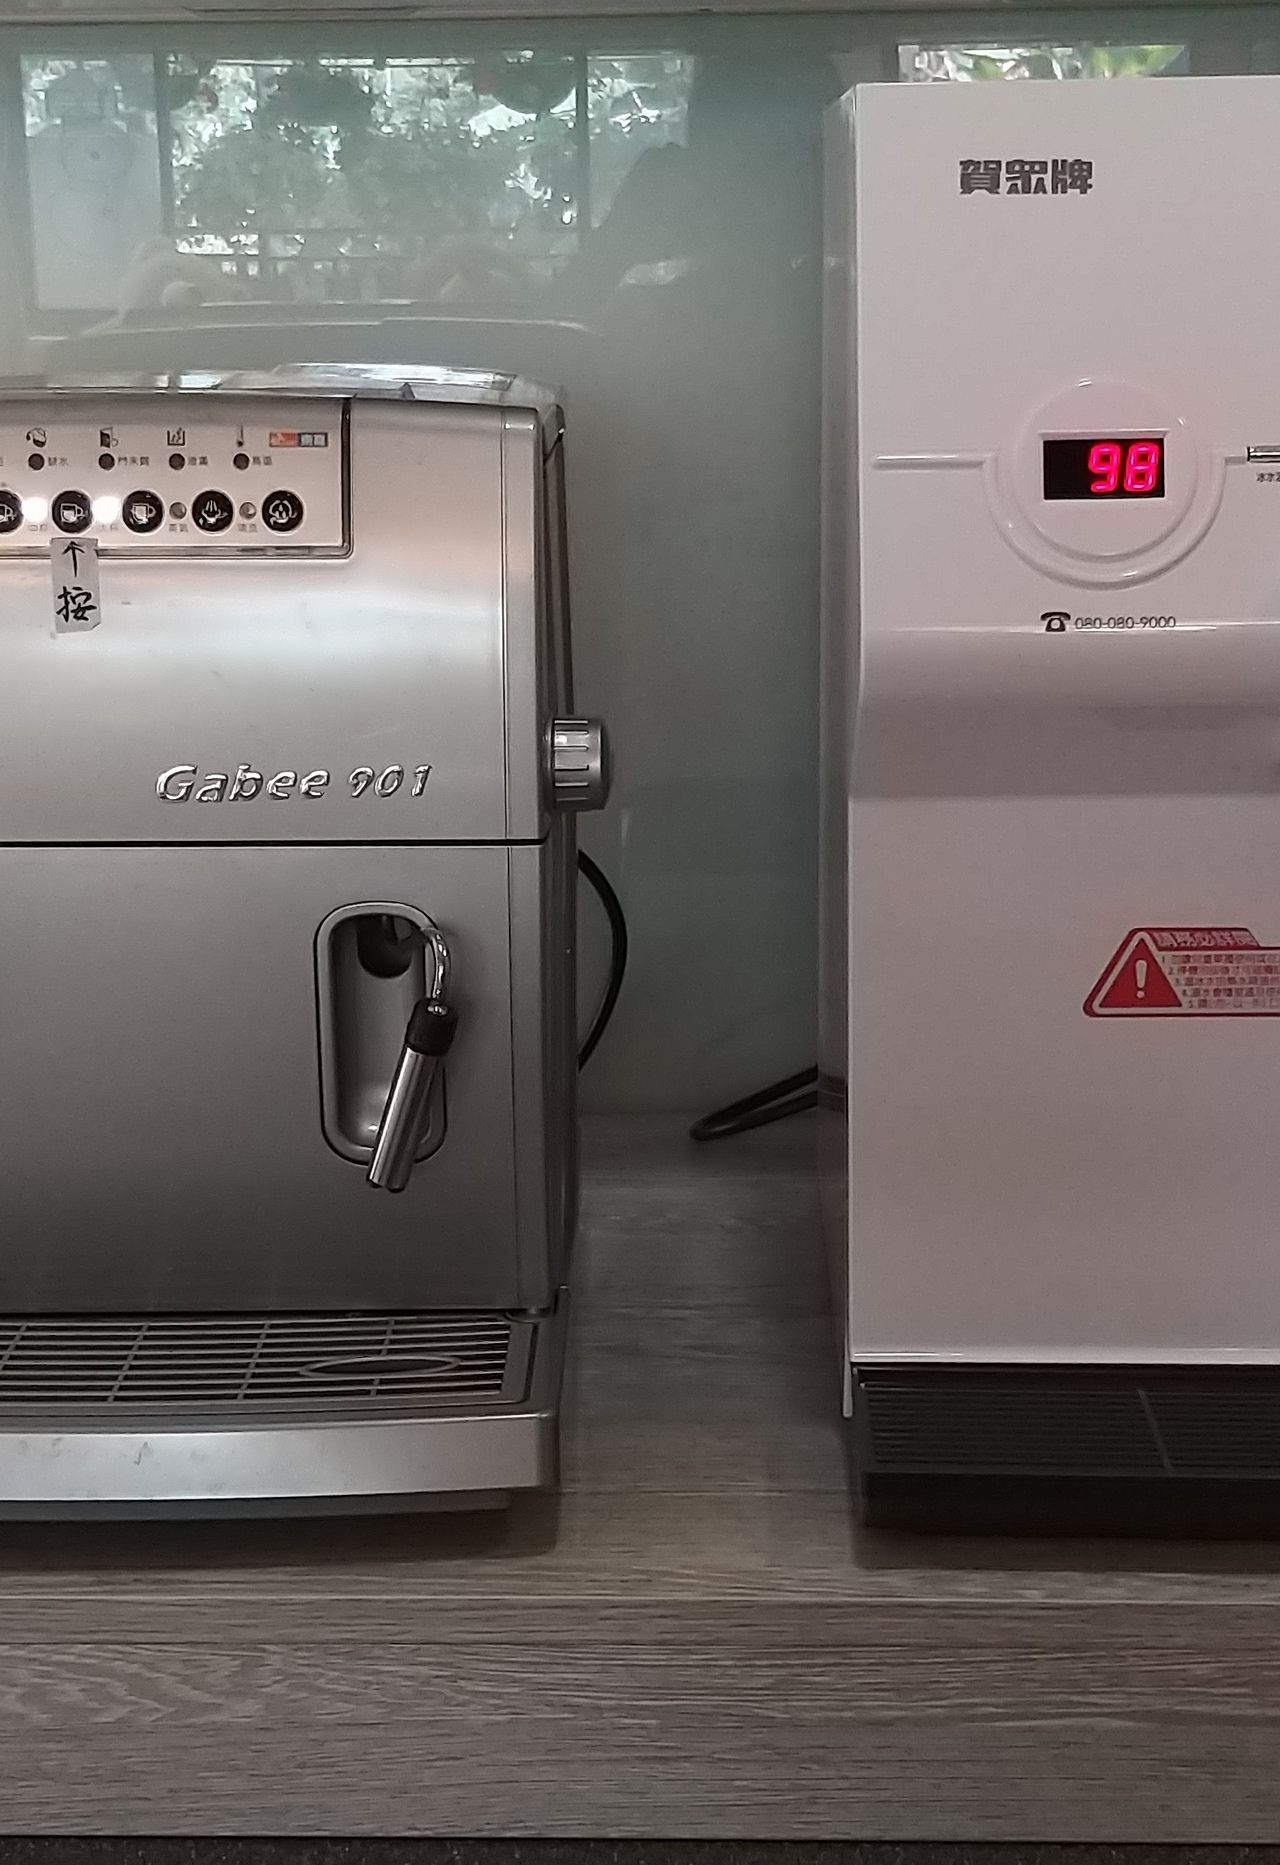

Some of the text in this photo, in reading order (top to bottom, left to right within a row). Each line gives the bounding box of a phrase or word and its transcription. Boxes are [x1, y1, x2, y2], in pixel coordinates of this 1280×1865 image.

[959, 159, 1093, 194] 賀眾牌
[1088, 443, 1160, 493] 98
[56, 586, 98, 623] 按
[1075, 616, 1176, 629] 080-080-9000
[154, 763, 432, 803] Gabee 901
